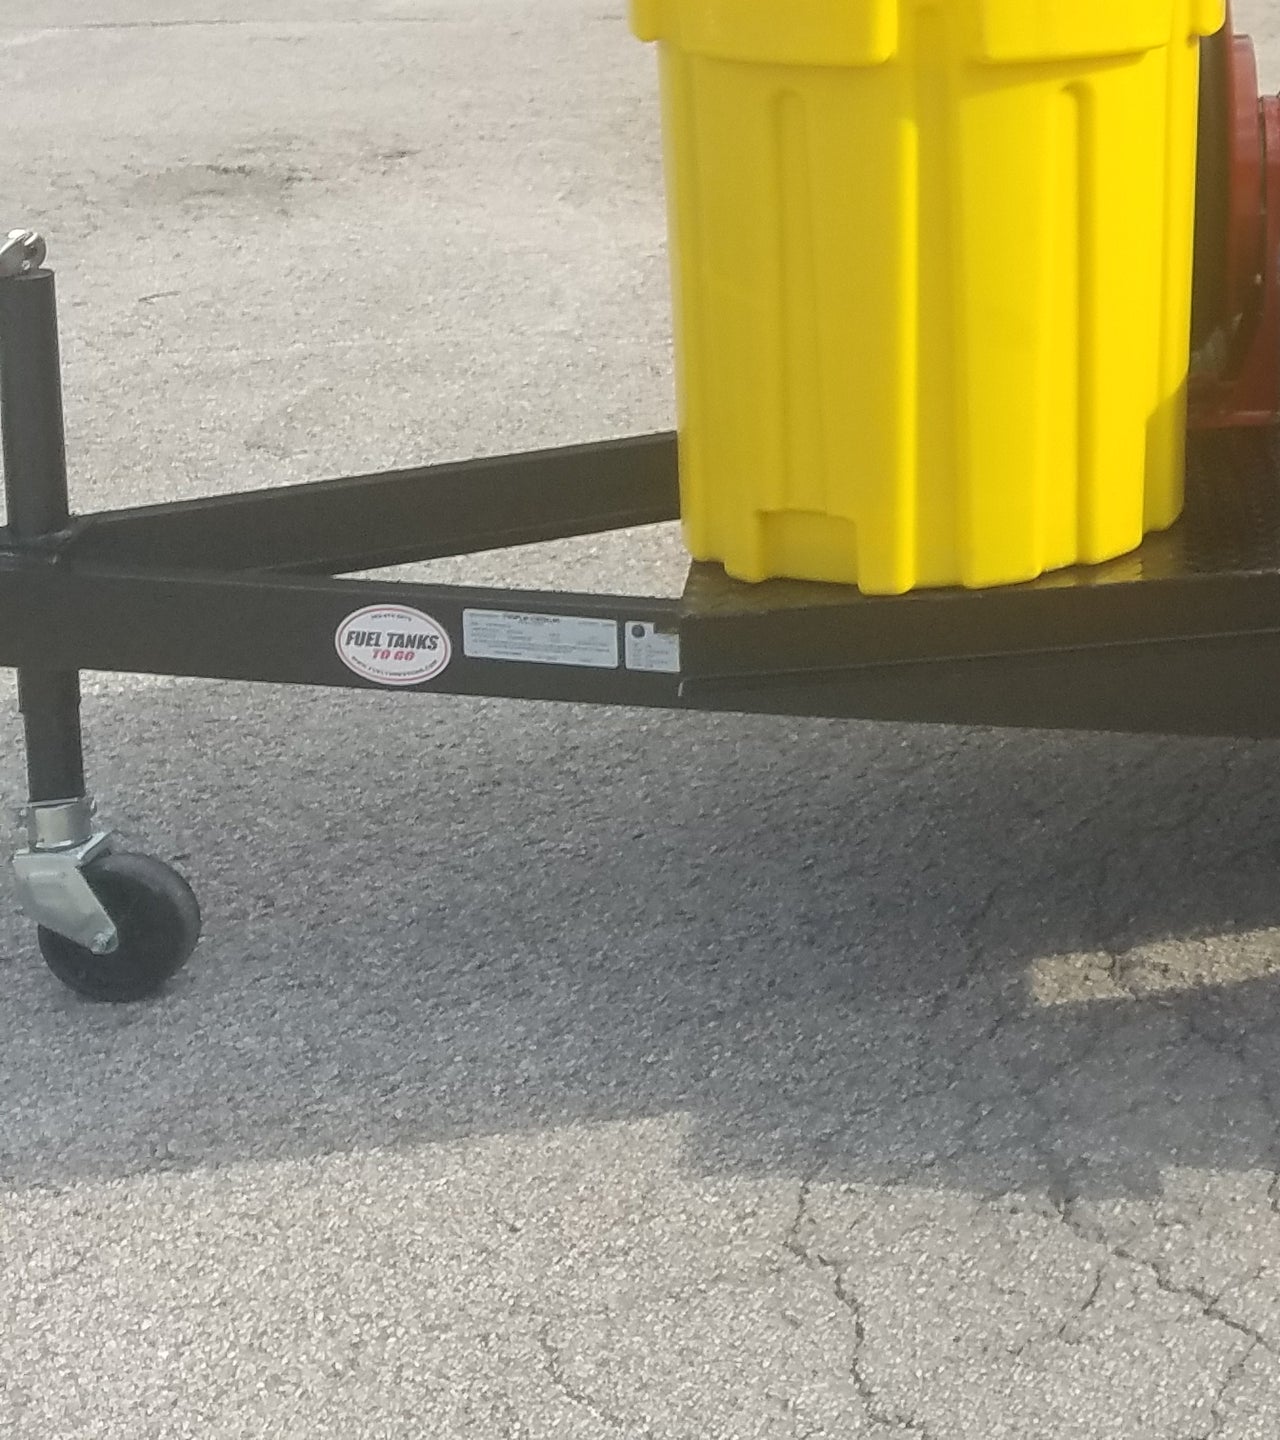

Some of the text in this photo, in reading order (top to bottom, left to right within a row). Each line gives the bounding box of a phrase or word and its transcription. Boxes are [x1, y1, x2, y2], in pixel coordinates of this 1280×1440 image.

[345, 630, 440, 651] FUEL TANKS
[372, 648, 416, 661] TO GO
